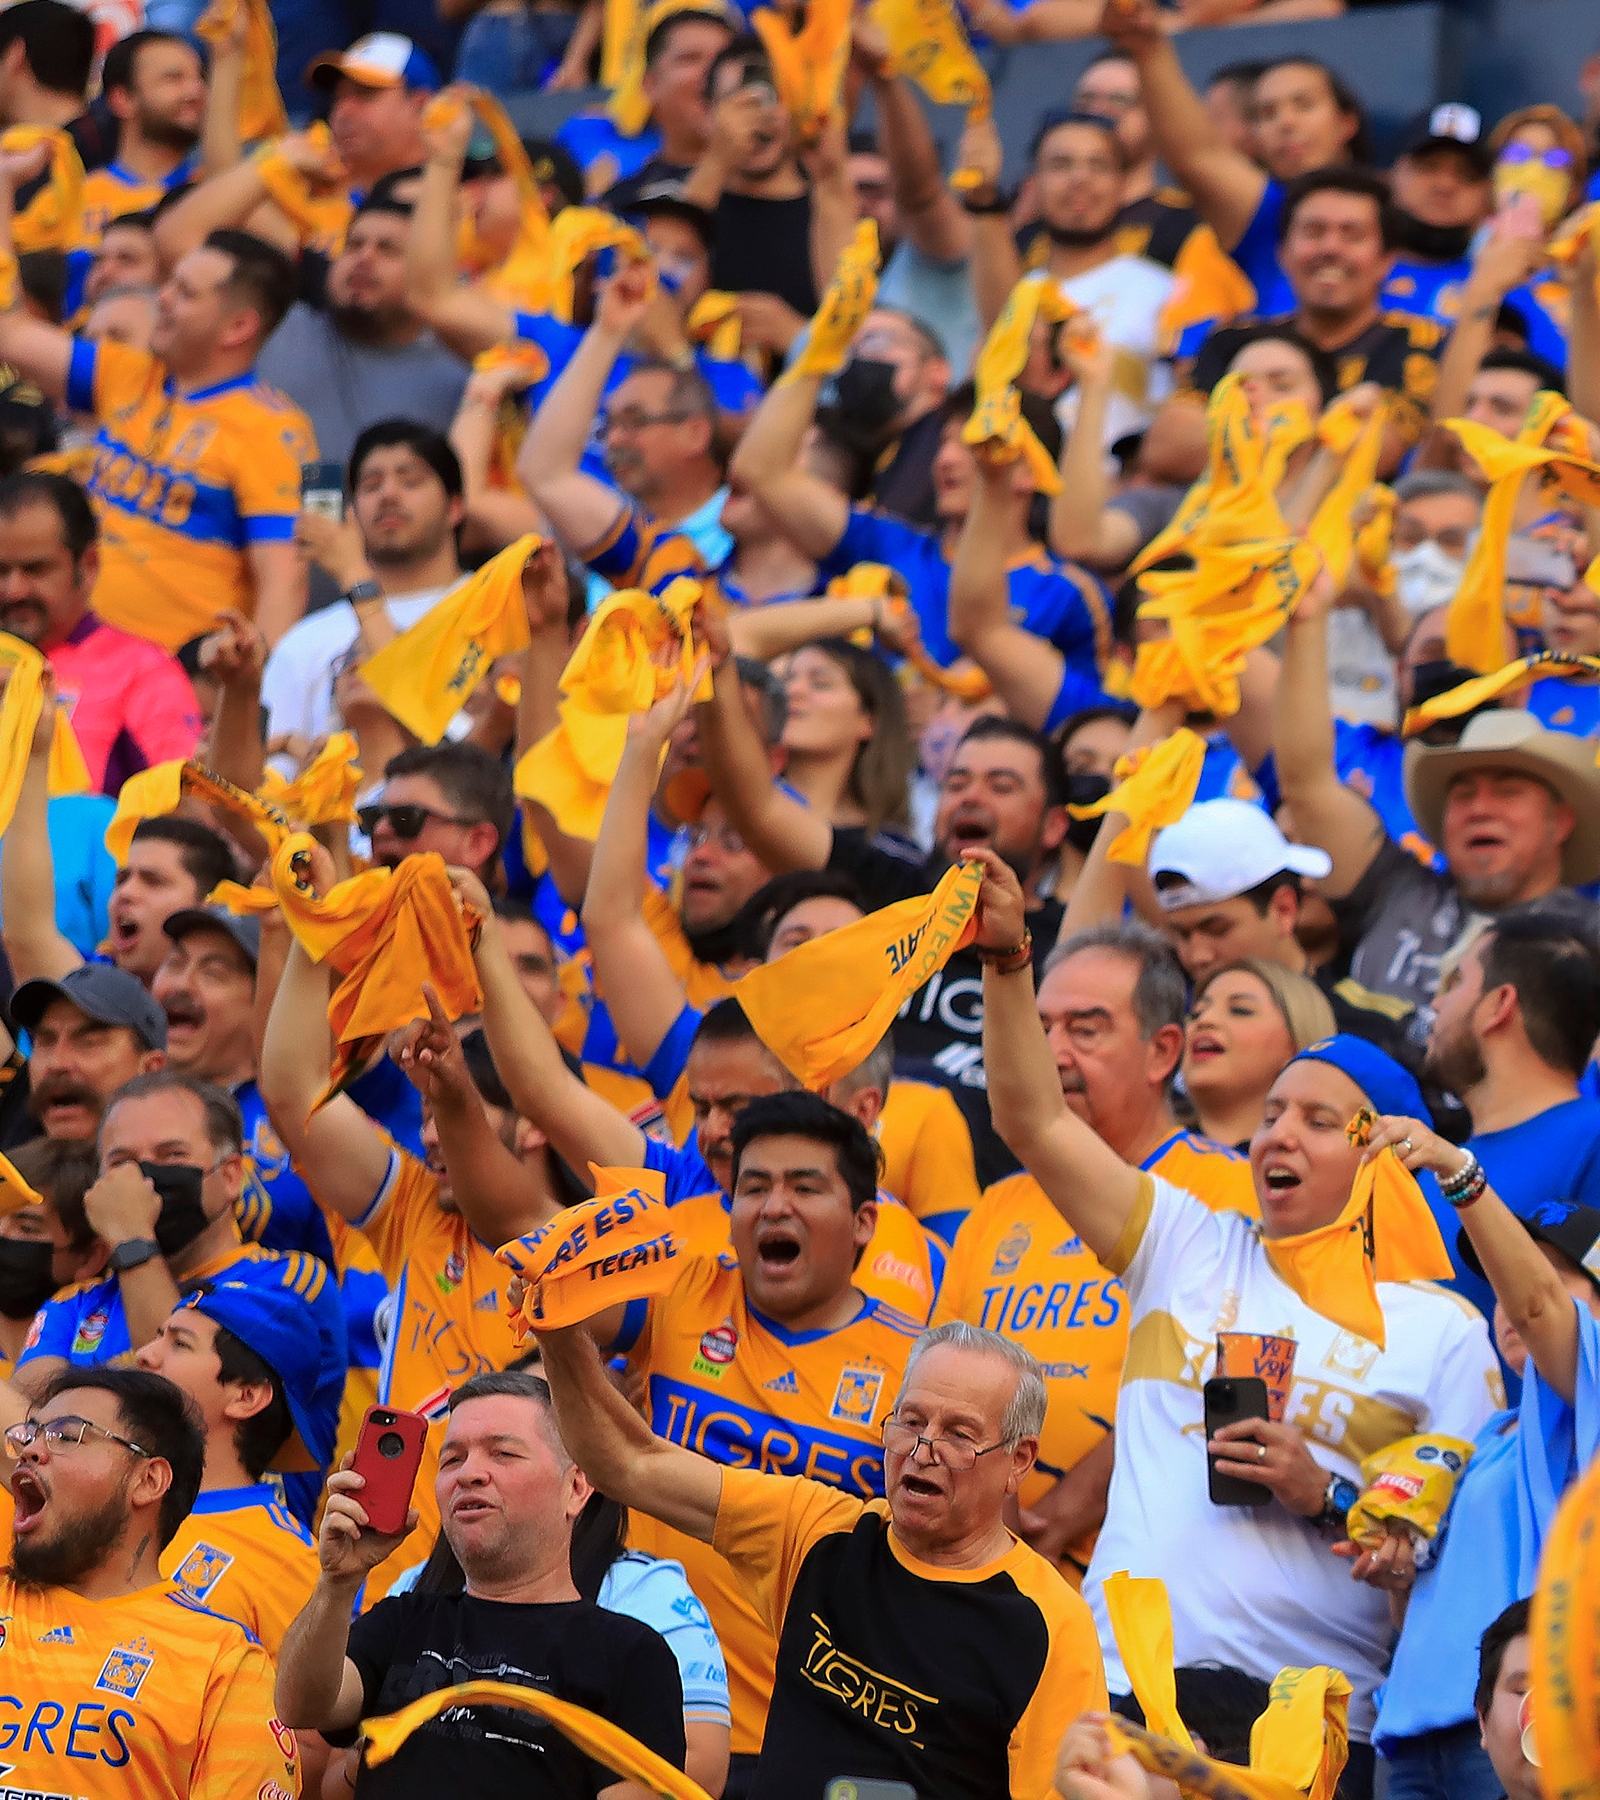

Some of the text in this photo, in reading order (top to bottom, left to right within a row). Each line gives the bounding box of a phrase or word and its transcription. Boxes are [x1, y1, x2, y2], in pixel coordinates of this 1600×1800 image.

[594, 1188, 660, 1239] EST
[585, 1231, 678, 1281] TECATE
[979, 1278, 1124, 1333] TIGRES
[664, 1393, 881, 1501] TIGRES
[806, 1631, 919, 1734] TIGRES
